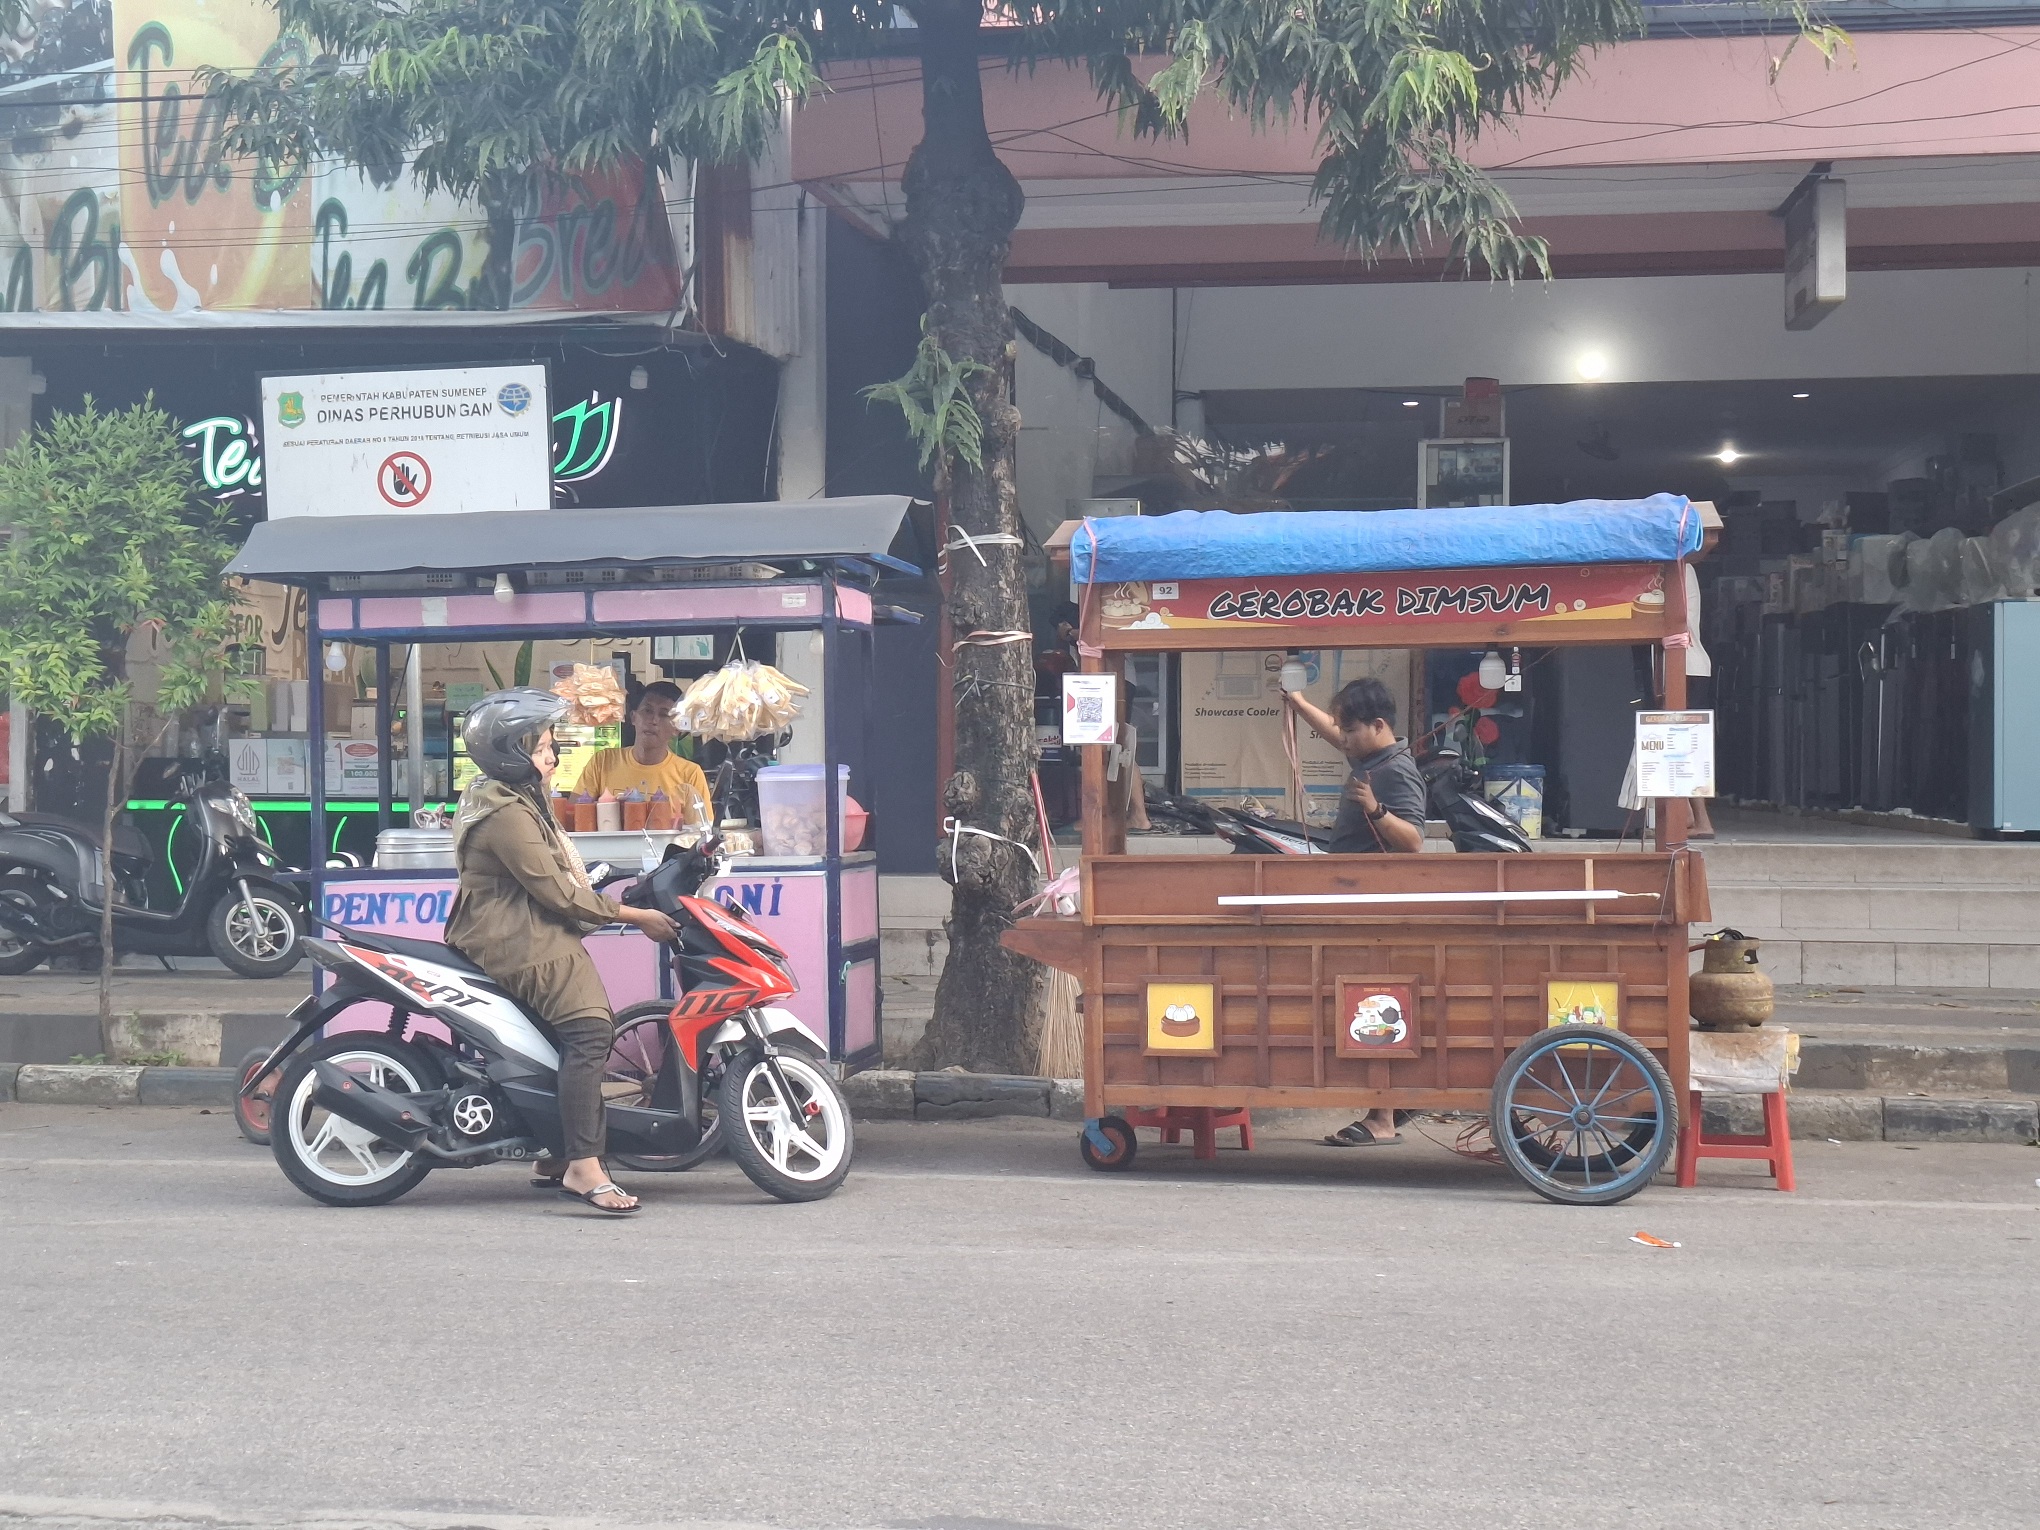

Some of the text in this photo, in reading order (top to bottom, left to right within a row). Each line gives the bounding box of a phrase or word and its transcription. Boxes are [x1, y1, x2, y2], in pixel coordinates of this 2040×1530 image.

[321, 387, 487, 402] PEMERINTAH KABUPATEN SUMENEP
[317, 402, 493, 423] DINAS PERHUBUNGAN
[1158, 586, 1173, 595] 92
[1207, 583, 1551, 620] GEROBAK DIMSUM
[1194, 707, 1281, 717] Showcase Cooler
[1641, 740, 1665, 751] MENU
[326, 889, 453, 925] PENTOL
